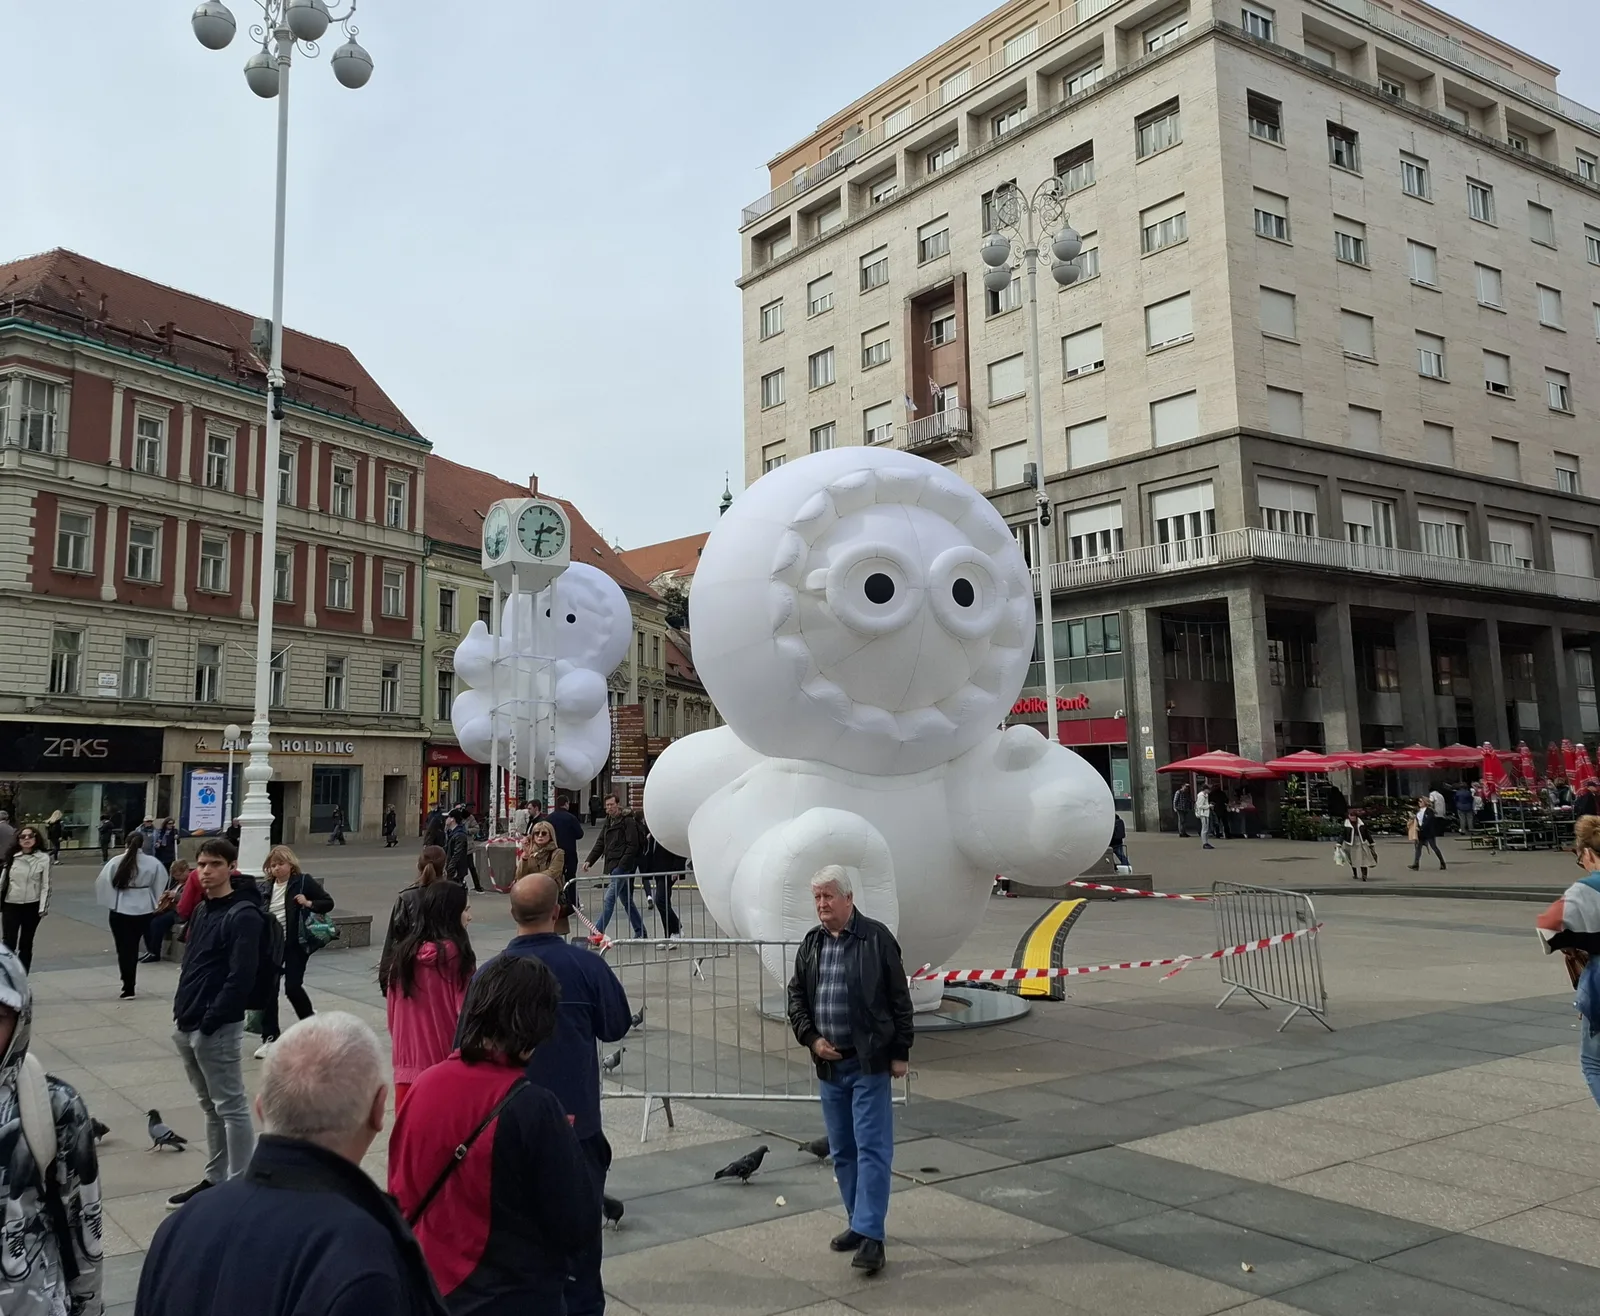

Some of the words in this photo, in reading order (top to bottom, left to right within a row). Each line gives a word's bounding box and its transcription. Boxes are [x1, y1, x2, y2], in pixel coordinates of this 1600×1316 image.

[1012, 697, 1047, 713] ddiko
[43, 737, 109, 757] ZAKS
[280, 740, 354, 753] HOLDING
